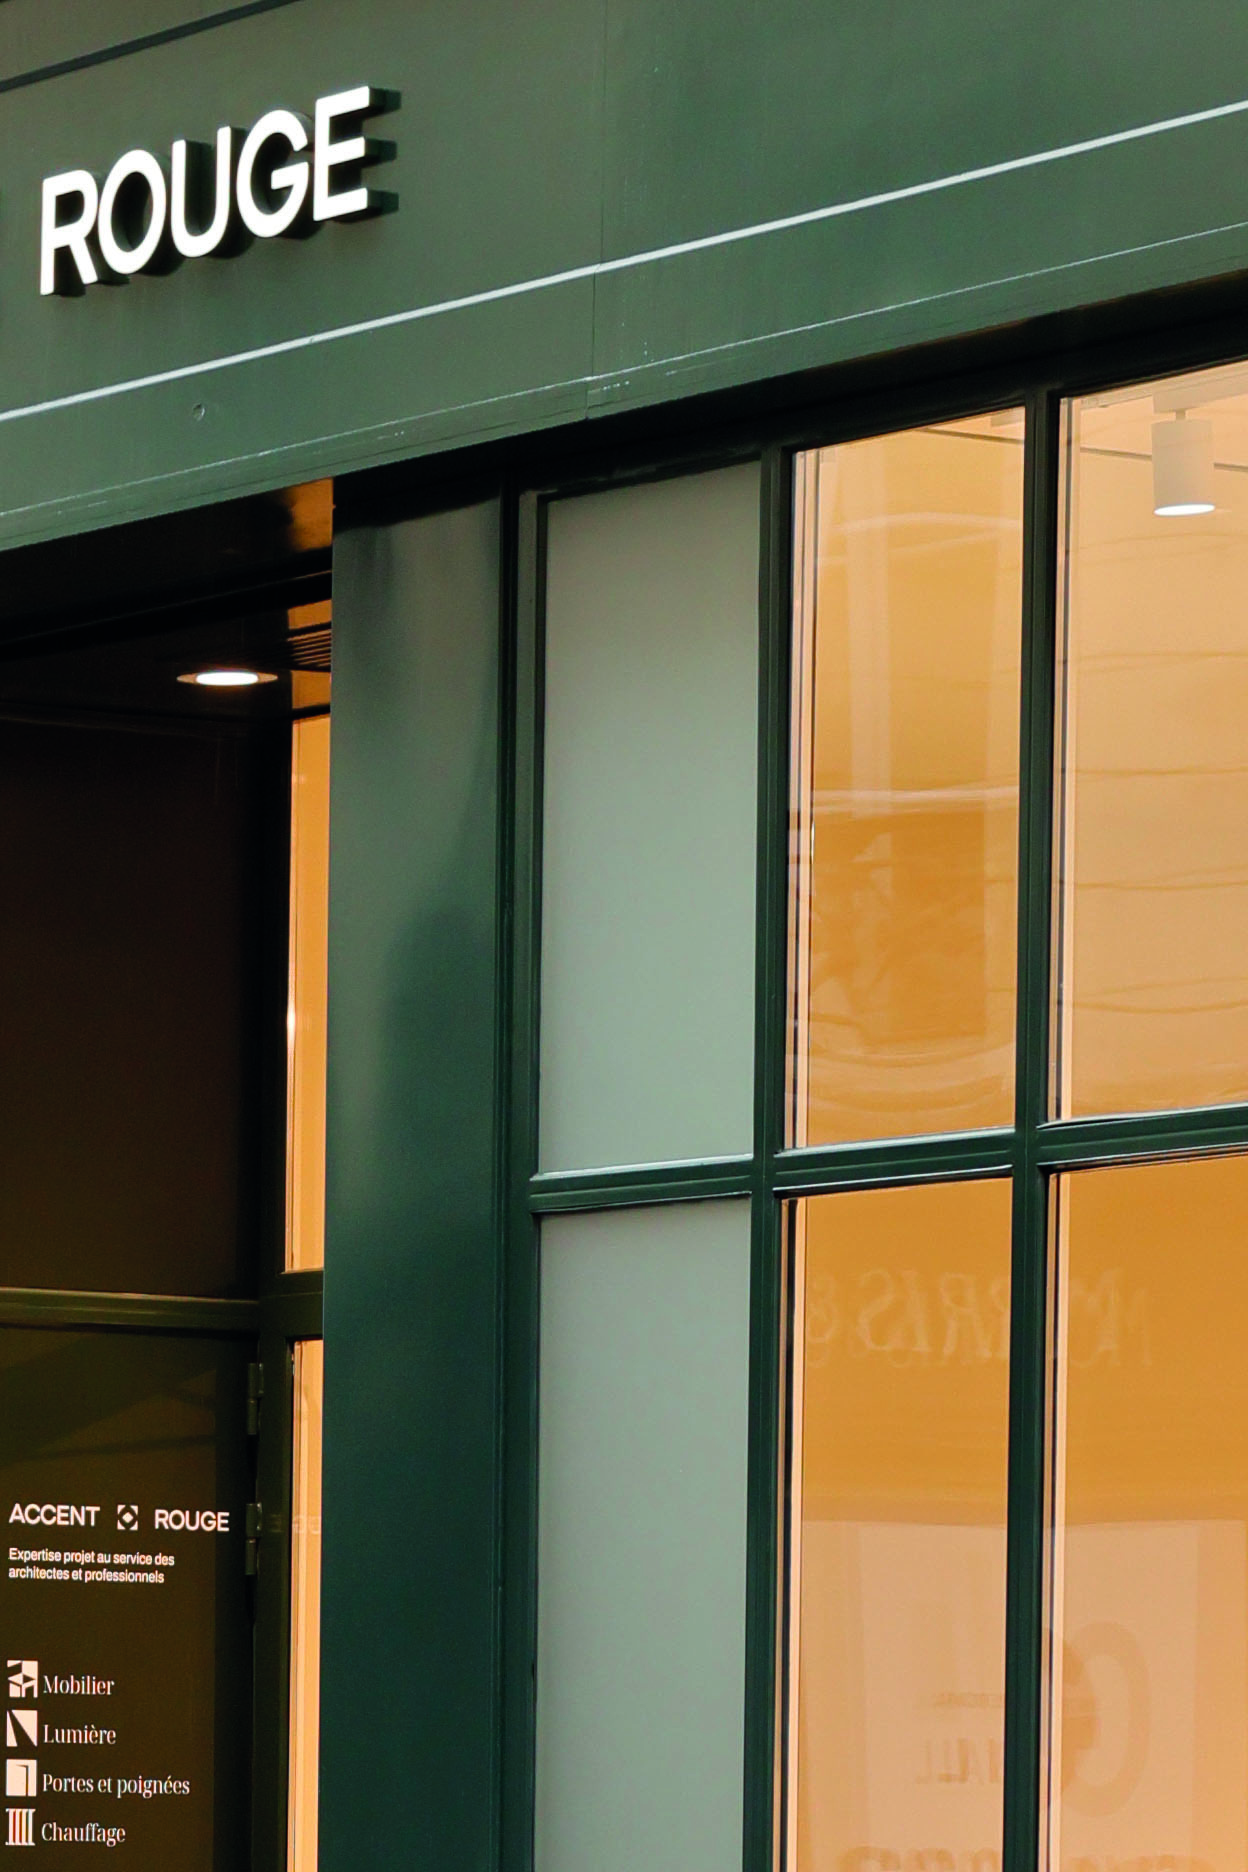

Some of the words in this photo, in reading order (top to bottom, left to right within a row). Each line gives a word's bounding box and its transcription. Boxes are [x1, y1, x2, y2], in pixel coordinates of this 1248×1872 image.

[40, 86, 371, 296] ROUGE
[8, 1502, 101, 1527] ACCENT
[154, 1508, 230, 1532] ROUGE
[8, 1547, 61, 1563] Expertise
[63, 1549, 95, 1565] projet
[97, 1552, 111, 1564] au
[113, 1551, 152, 1565] service
[154, 1552, 175, 1566] des
[8, 1565, 69, 1581] architectes
[72, 1567, 83, 1580] et
[84, 1568, 165, 1584] professionnels
[43, 1674, 115, 1696] Mobilier
[43, 1723, 117, 1745] Lumière
[43, 1773, 94, 1793] Portes
[97, 1777, 112, 1793] et
[117, 1775, 191, 1799] poignées
[41, 1821, 126, 1848] Chauffage
